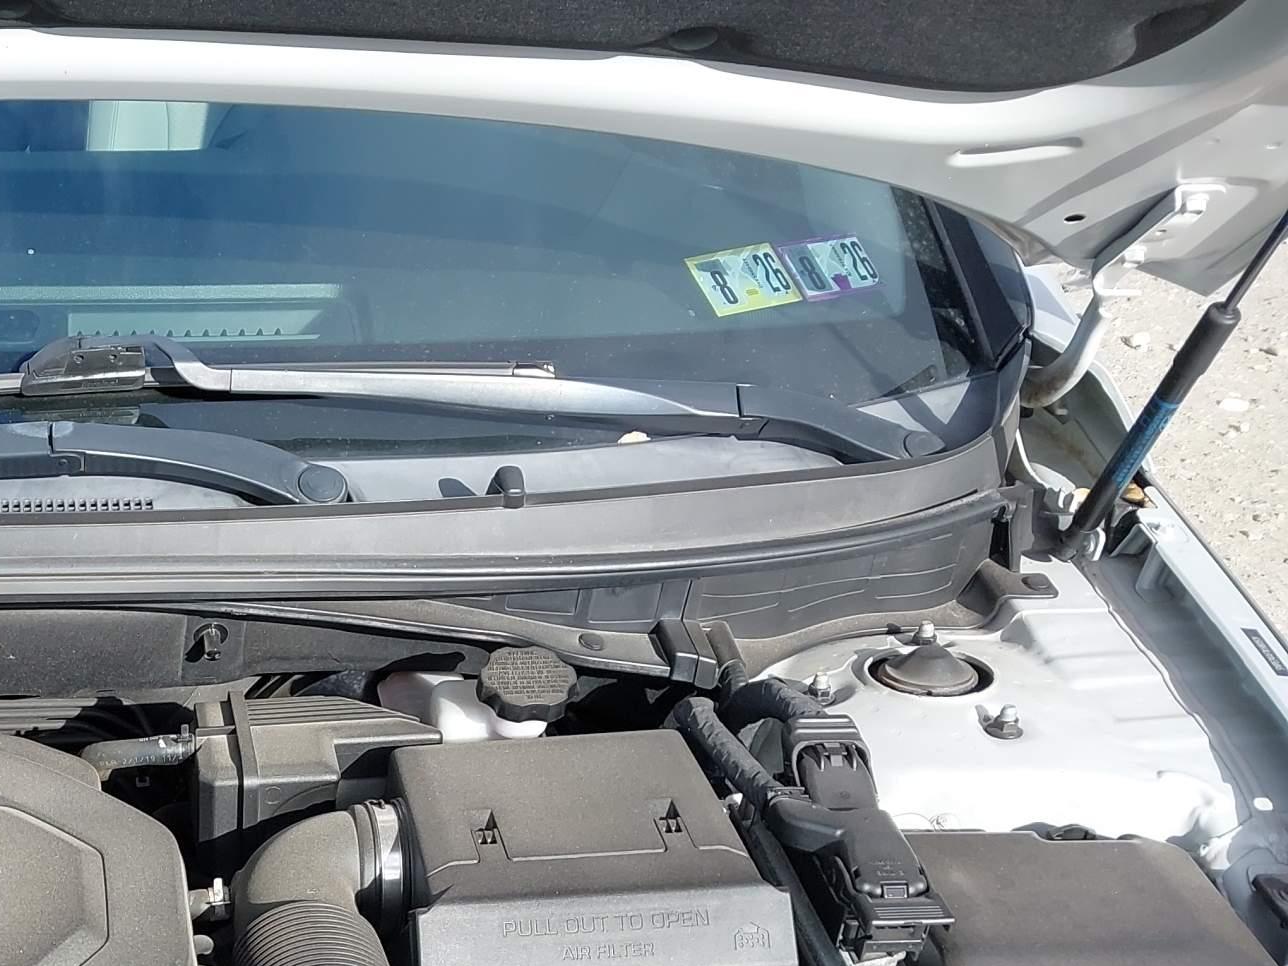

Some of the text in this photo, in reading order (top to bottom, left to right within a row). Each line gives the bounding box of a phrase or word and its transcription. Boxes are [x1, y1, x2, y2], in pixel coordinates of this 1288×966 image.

[711, 271, 739, 305] 8
[752, 252, 792, 293] 26
[799, 255, 826, 290] 8
[840, 240, 877, 280] 26
[502, 909, 712, 937] PULL OUT TO OPEN
[562, 942, 655, 961] AIR FILTER
